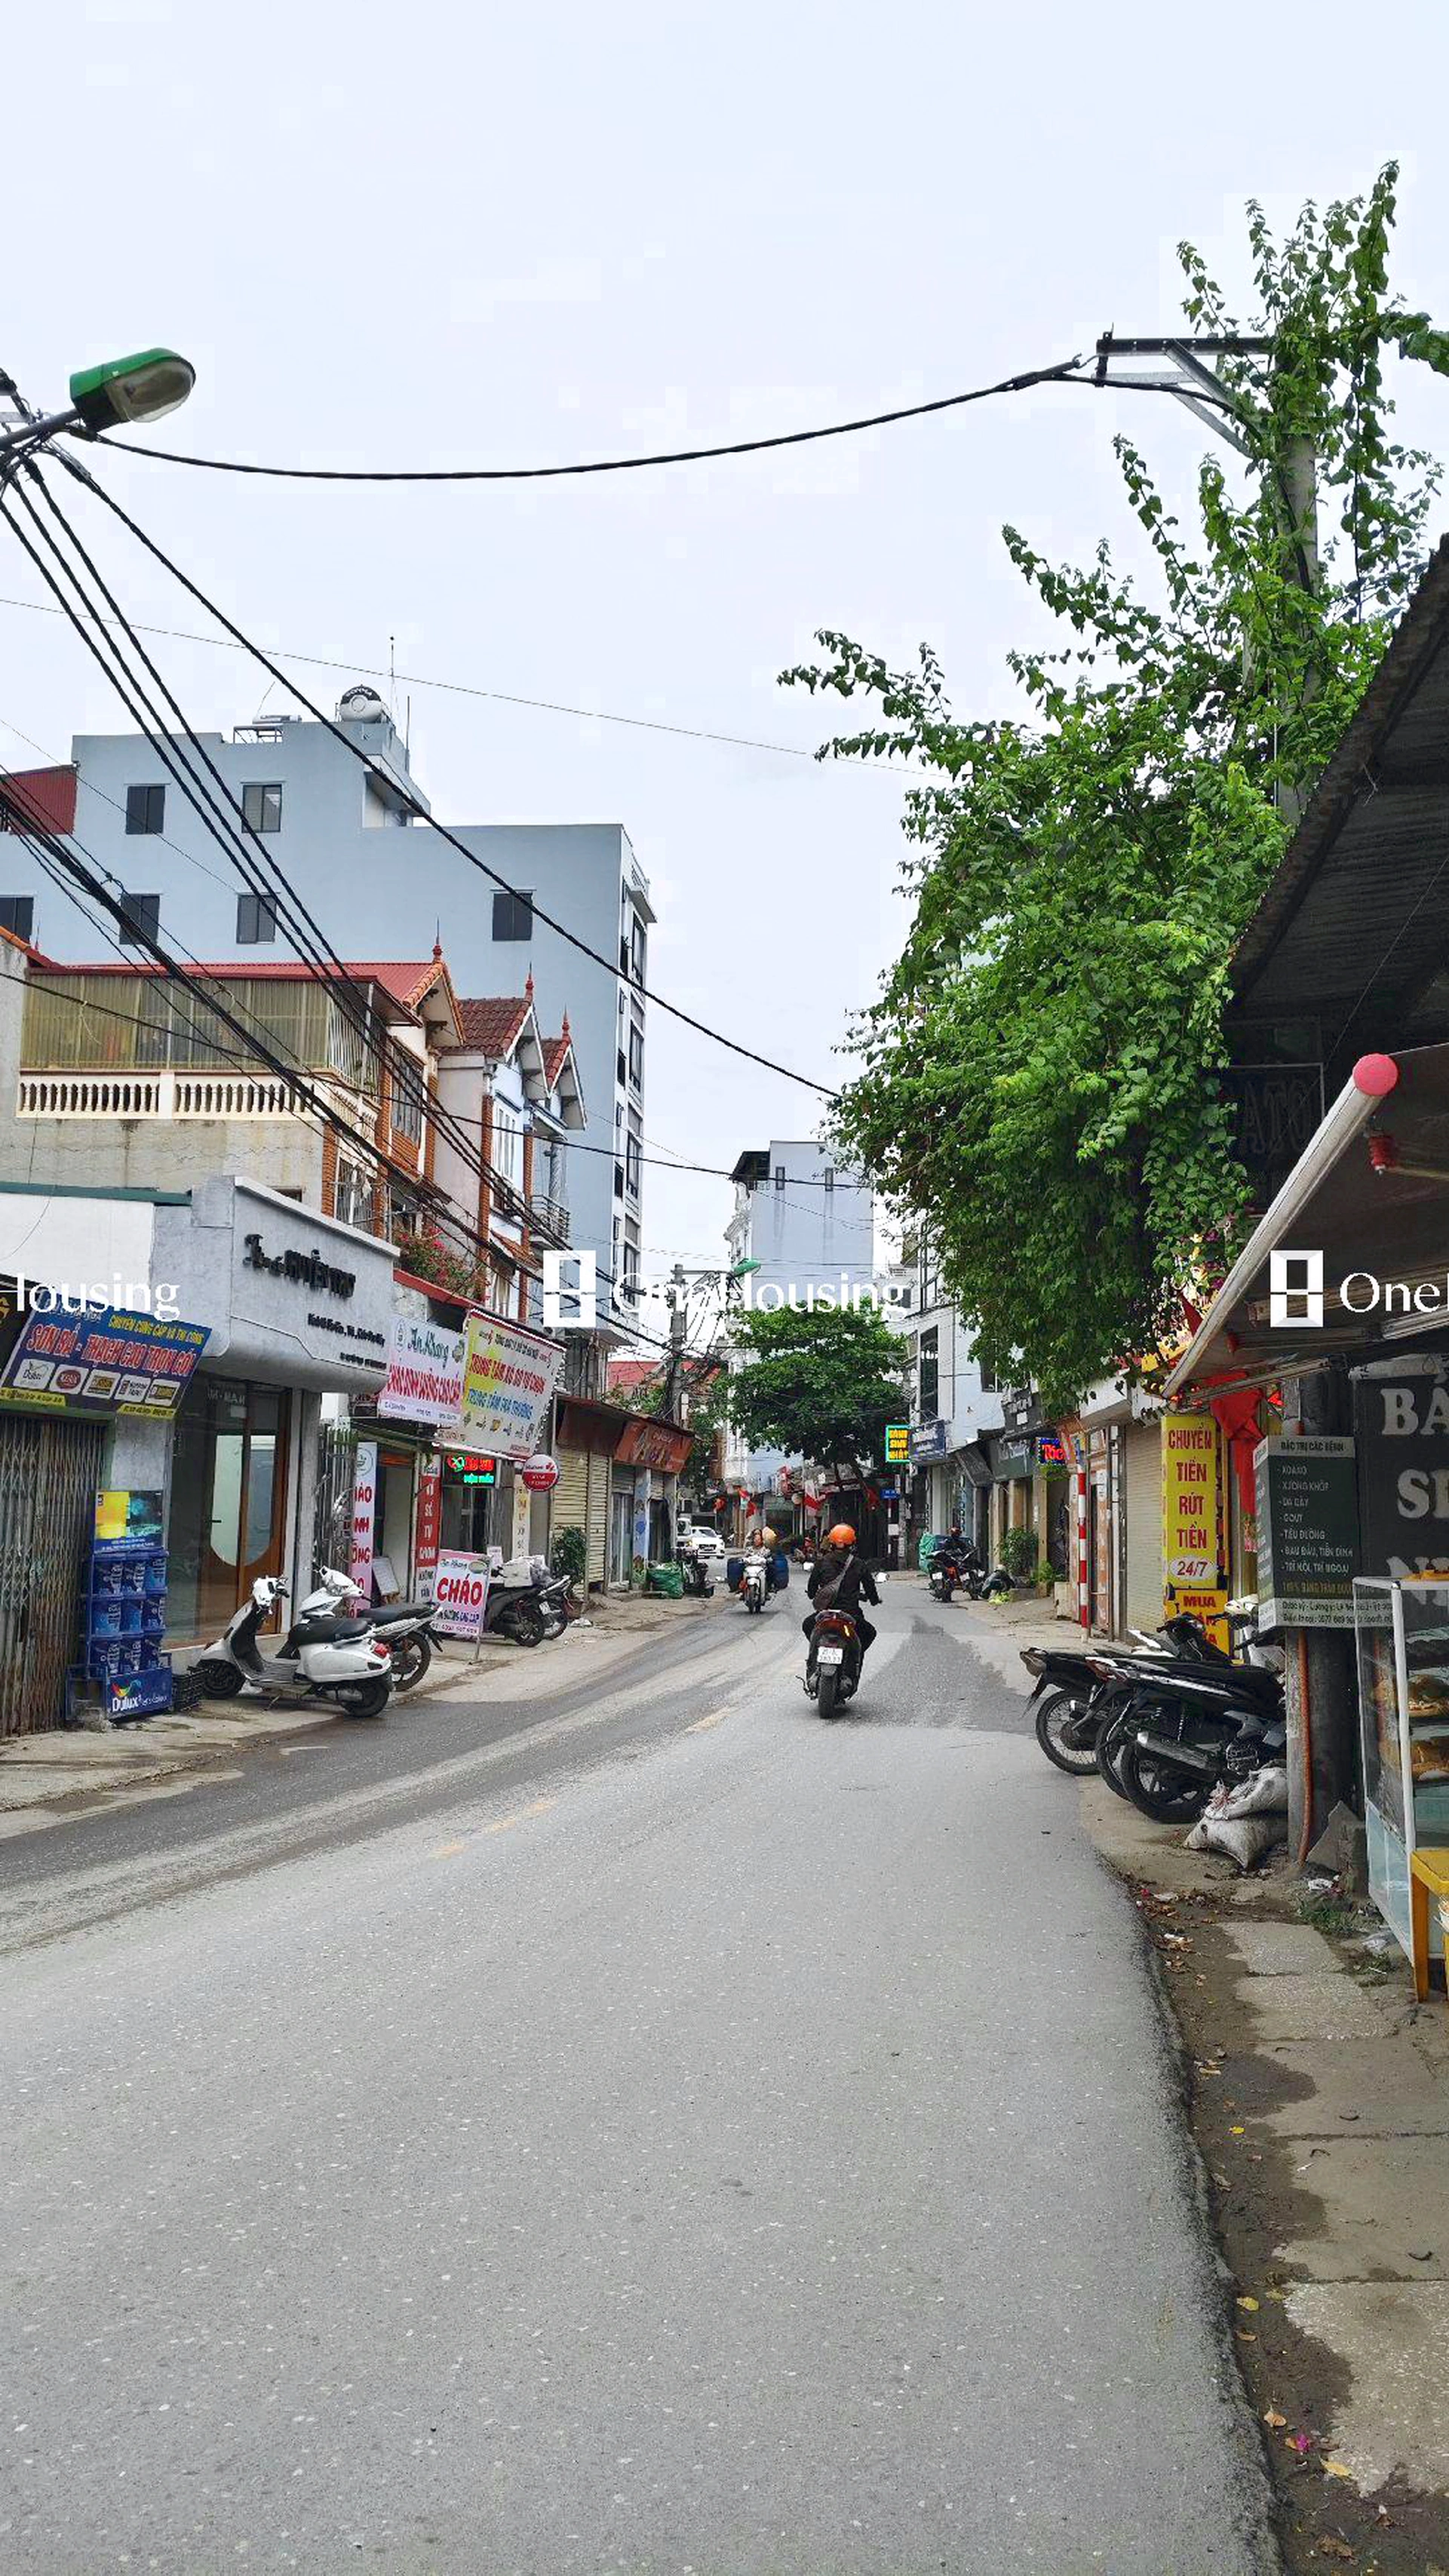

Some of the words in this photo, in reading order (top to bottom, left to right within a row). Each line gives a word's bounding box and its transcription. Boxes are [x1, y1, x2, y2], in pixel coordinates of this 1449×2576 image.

[1176, 1457, 1207, 1482] TIỀN
[1179, 1491, 1205, 1515] RÚT
[1176, 1521, 1207, 1549] TIỀN
[1177, 1561, 1208, 1575] 24/7
[437, 1574, 483, 1607] CHÁO
[1183, 1595, 1217, 1607] MUA
[112, 1695, 139, 1712] Dulux
